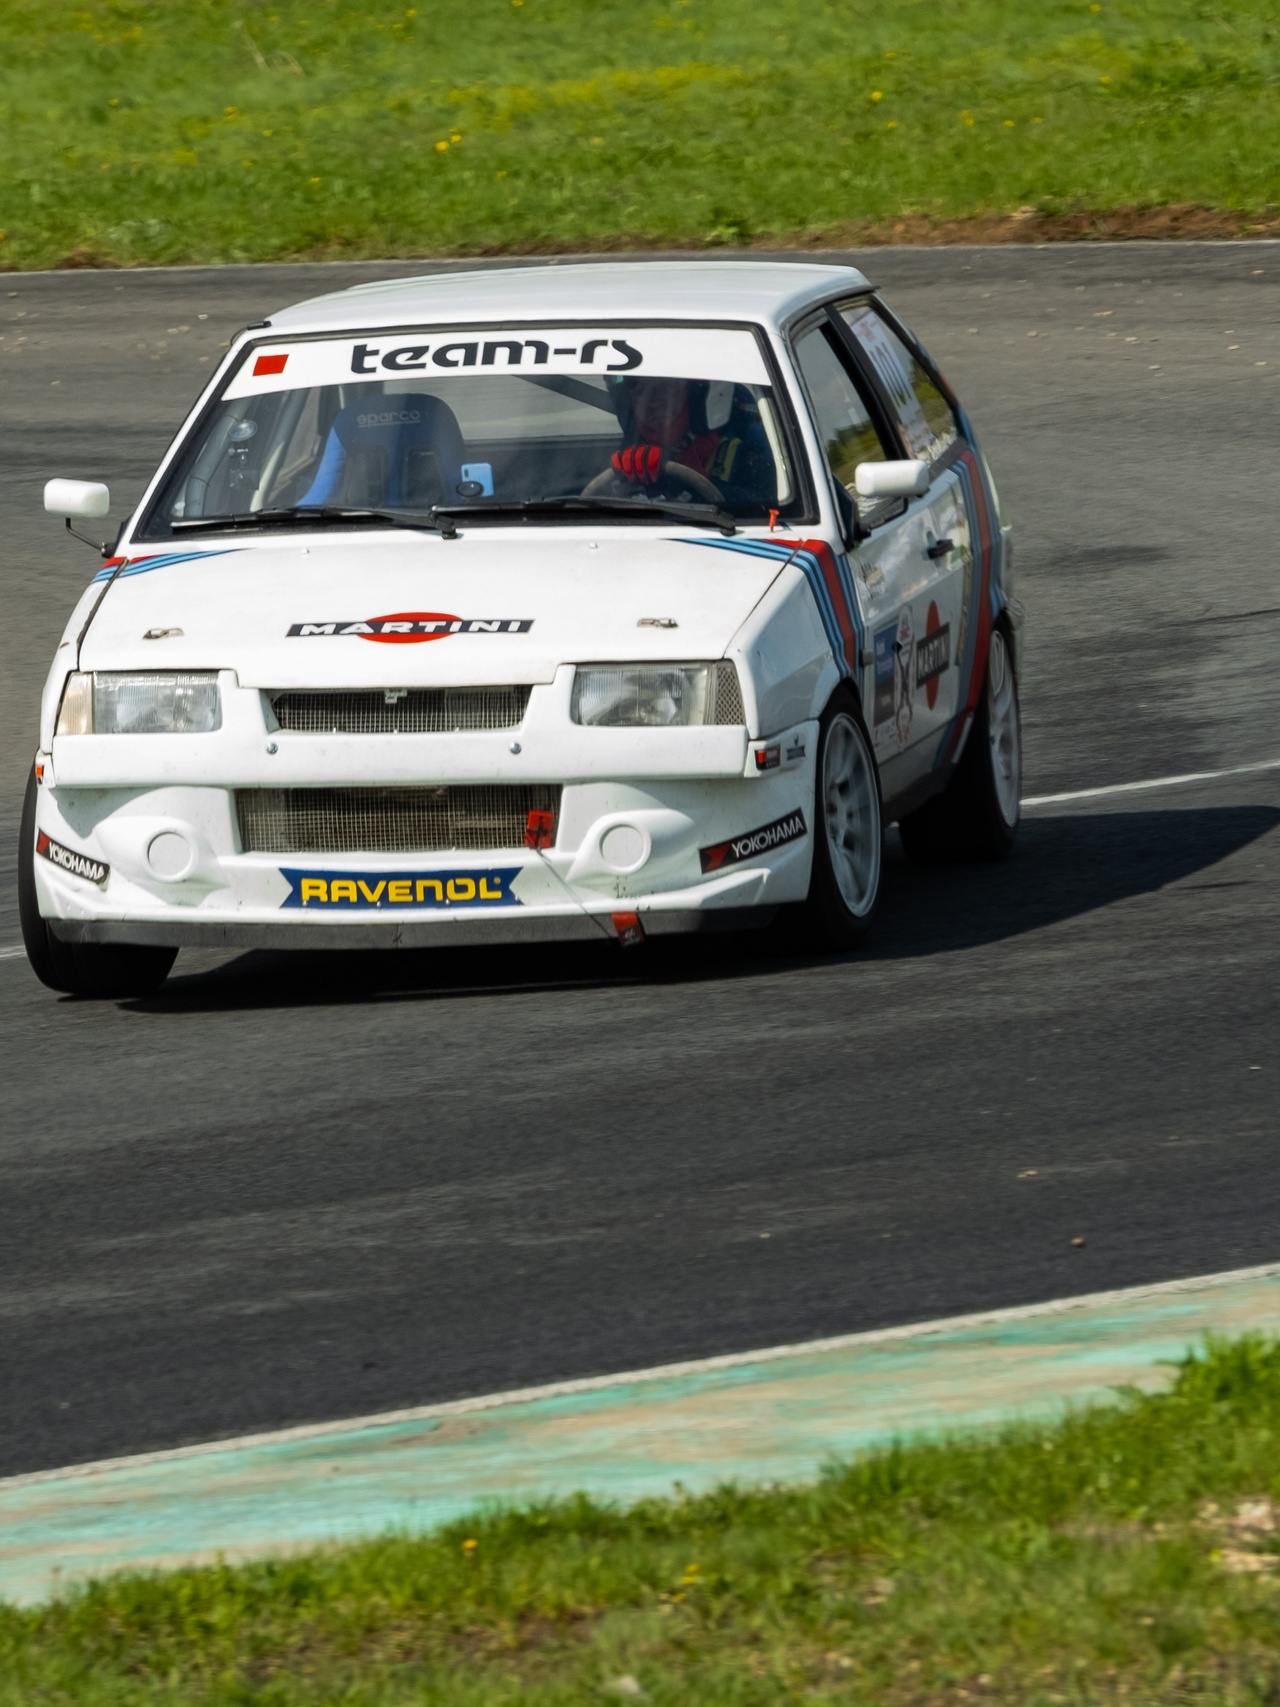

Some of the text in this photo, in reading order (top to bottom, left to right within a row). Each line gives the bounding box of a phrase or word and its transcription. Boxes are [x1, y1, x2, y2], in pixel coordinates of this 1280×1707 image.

[350, 339, 643, 374] team-rs
[299, 620, 522, 636] MARTINI
[731, 816, 804, 858] YOKOHAMA
[48, 841, 105, 880] YOKOHAMA
[301, 877, 502, 903] RAVENOL
